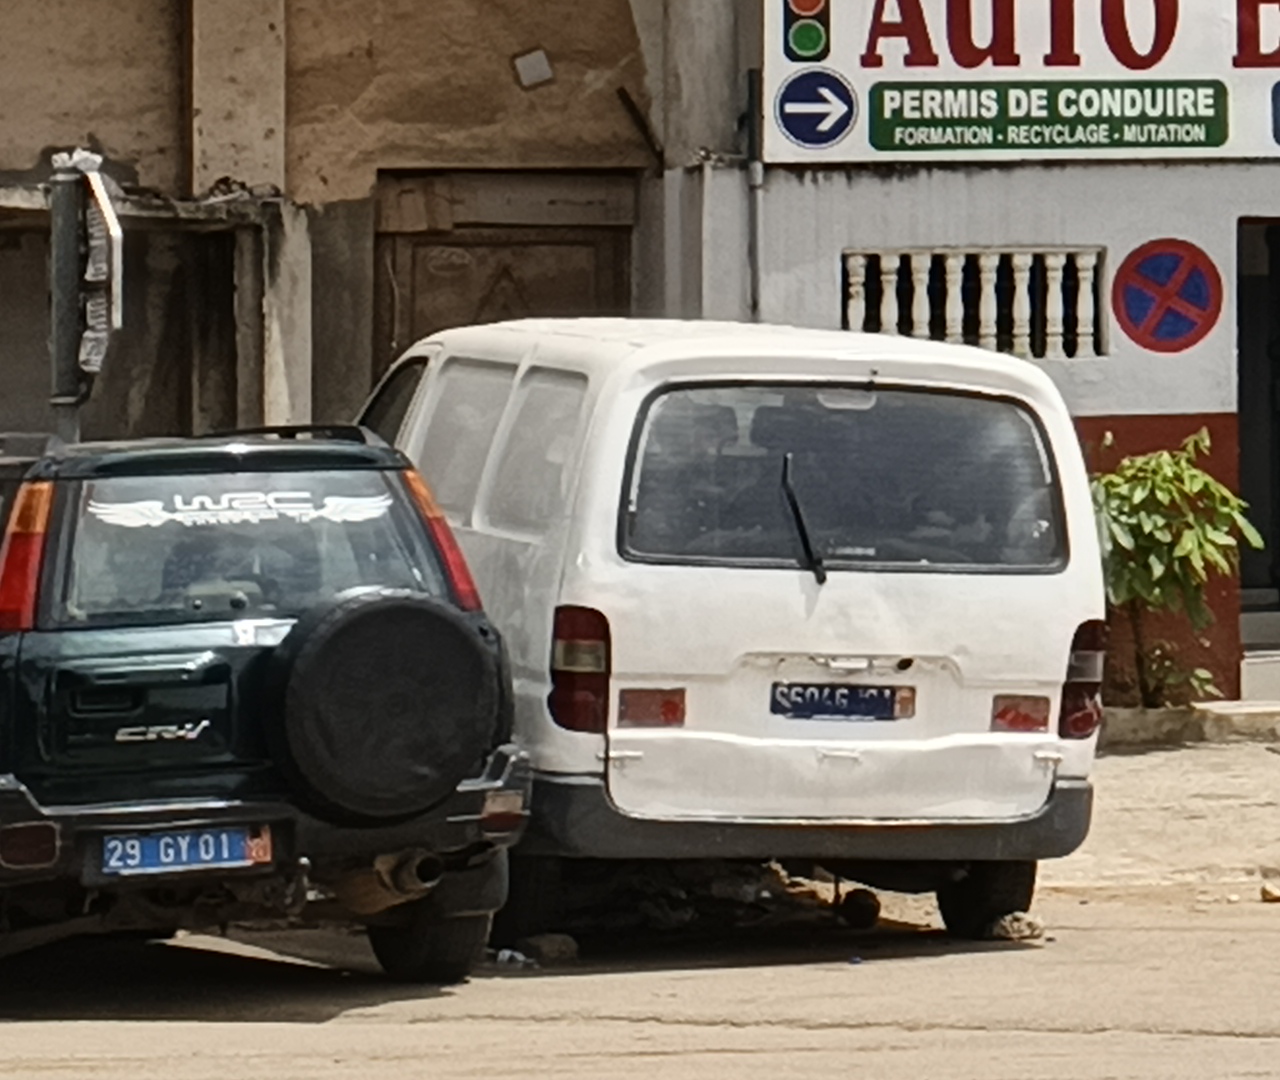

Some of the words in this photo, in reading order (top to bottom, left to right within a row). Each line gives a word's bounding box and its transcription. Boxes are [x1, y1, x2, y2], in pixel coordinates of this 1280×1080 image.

[883, 88, 999, 120] PERMIS
[1008, 88, 1049, 118] DE
[1058, 86, 1216, 119] CONDUIRE
[895, 124, 994, 146] FORMATION
[1007, 123, 1111, 145] RECYCLAGE
[1123, 122, 1206, 144] MUTATION
[174, 491, 314, 510] WRC
[107, 839, 141, 867] 29
[159, 835, 190, 863] GY
[199, 832, 229, 860] 01
